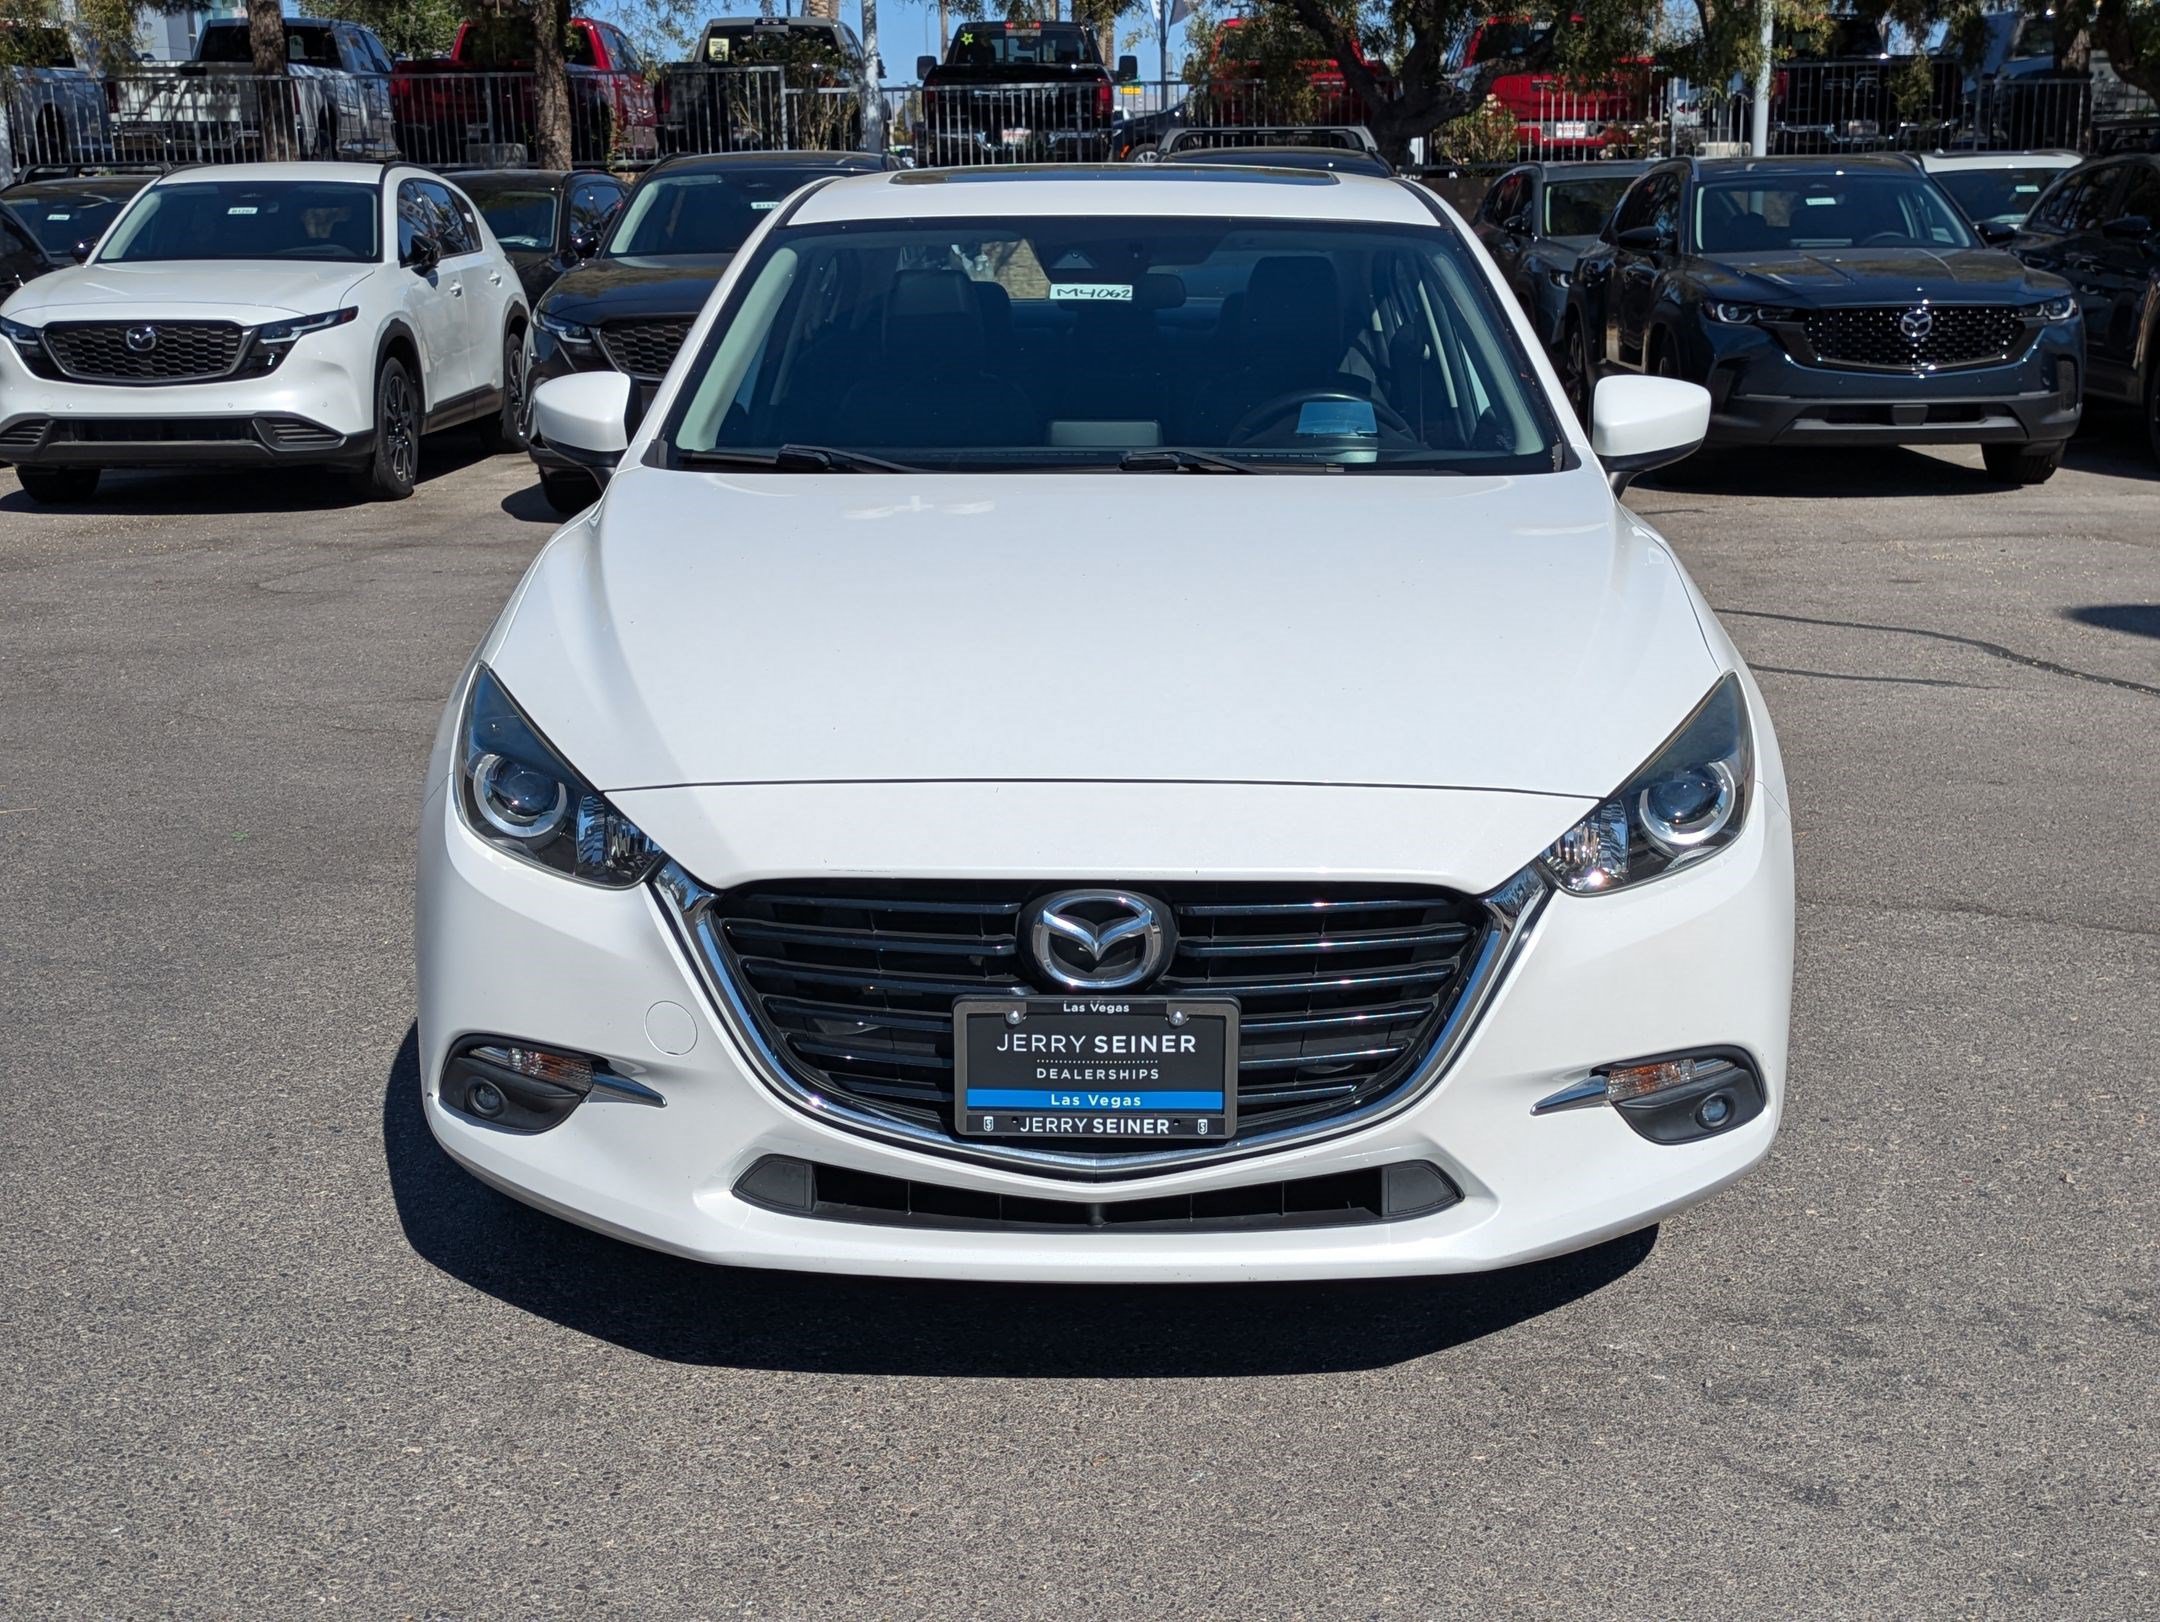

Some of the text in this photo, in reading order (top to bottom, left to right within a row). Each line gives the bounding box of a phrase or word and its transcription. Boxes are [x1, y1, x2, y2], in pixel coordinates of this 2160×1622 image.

[1056, 288, 1132, 298] M4062
[1063, 1001, 1129, 1013] Las Vegas
[997, 1034, 1196, 1053] JERRY SEINER
[1036, 1068, 1159, 1080] DEALERSHIPS
[1051, 1094, 1141, 1108] Las Vegas
[1020, 1117, 1169, 1134] JERRY SEINER
